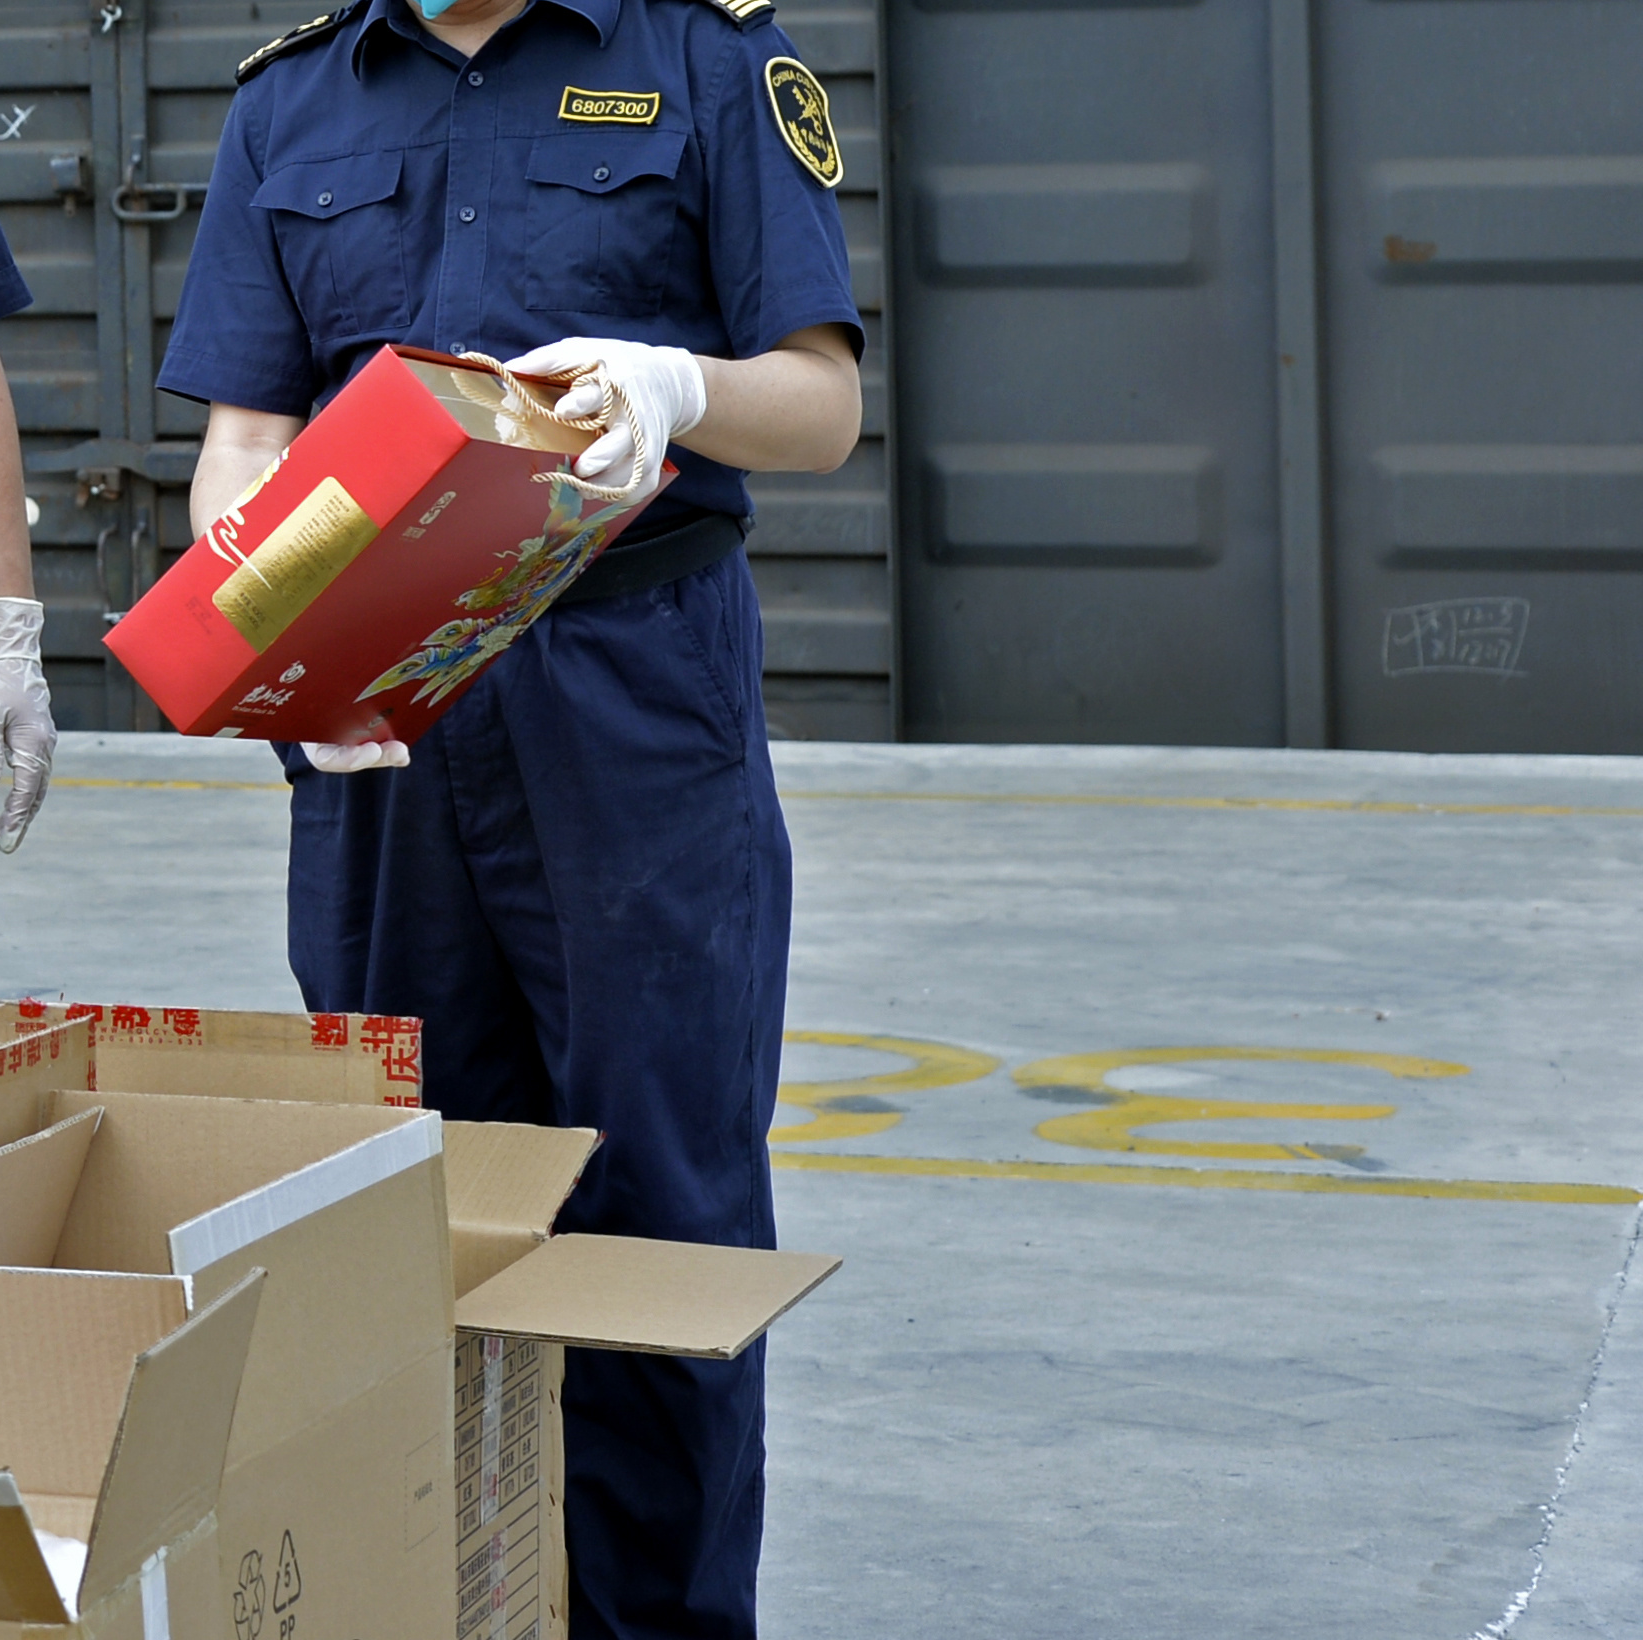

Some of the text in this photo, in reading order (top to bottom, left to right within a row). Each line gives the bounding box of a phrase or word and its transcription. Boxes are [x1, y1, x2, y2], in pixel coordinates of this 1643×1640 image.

[571, 98, 649, 117] 6807300
[283, 1562, 292, 1588] 5
[280, 1614, 295, 1640] PP
